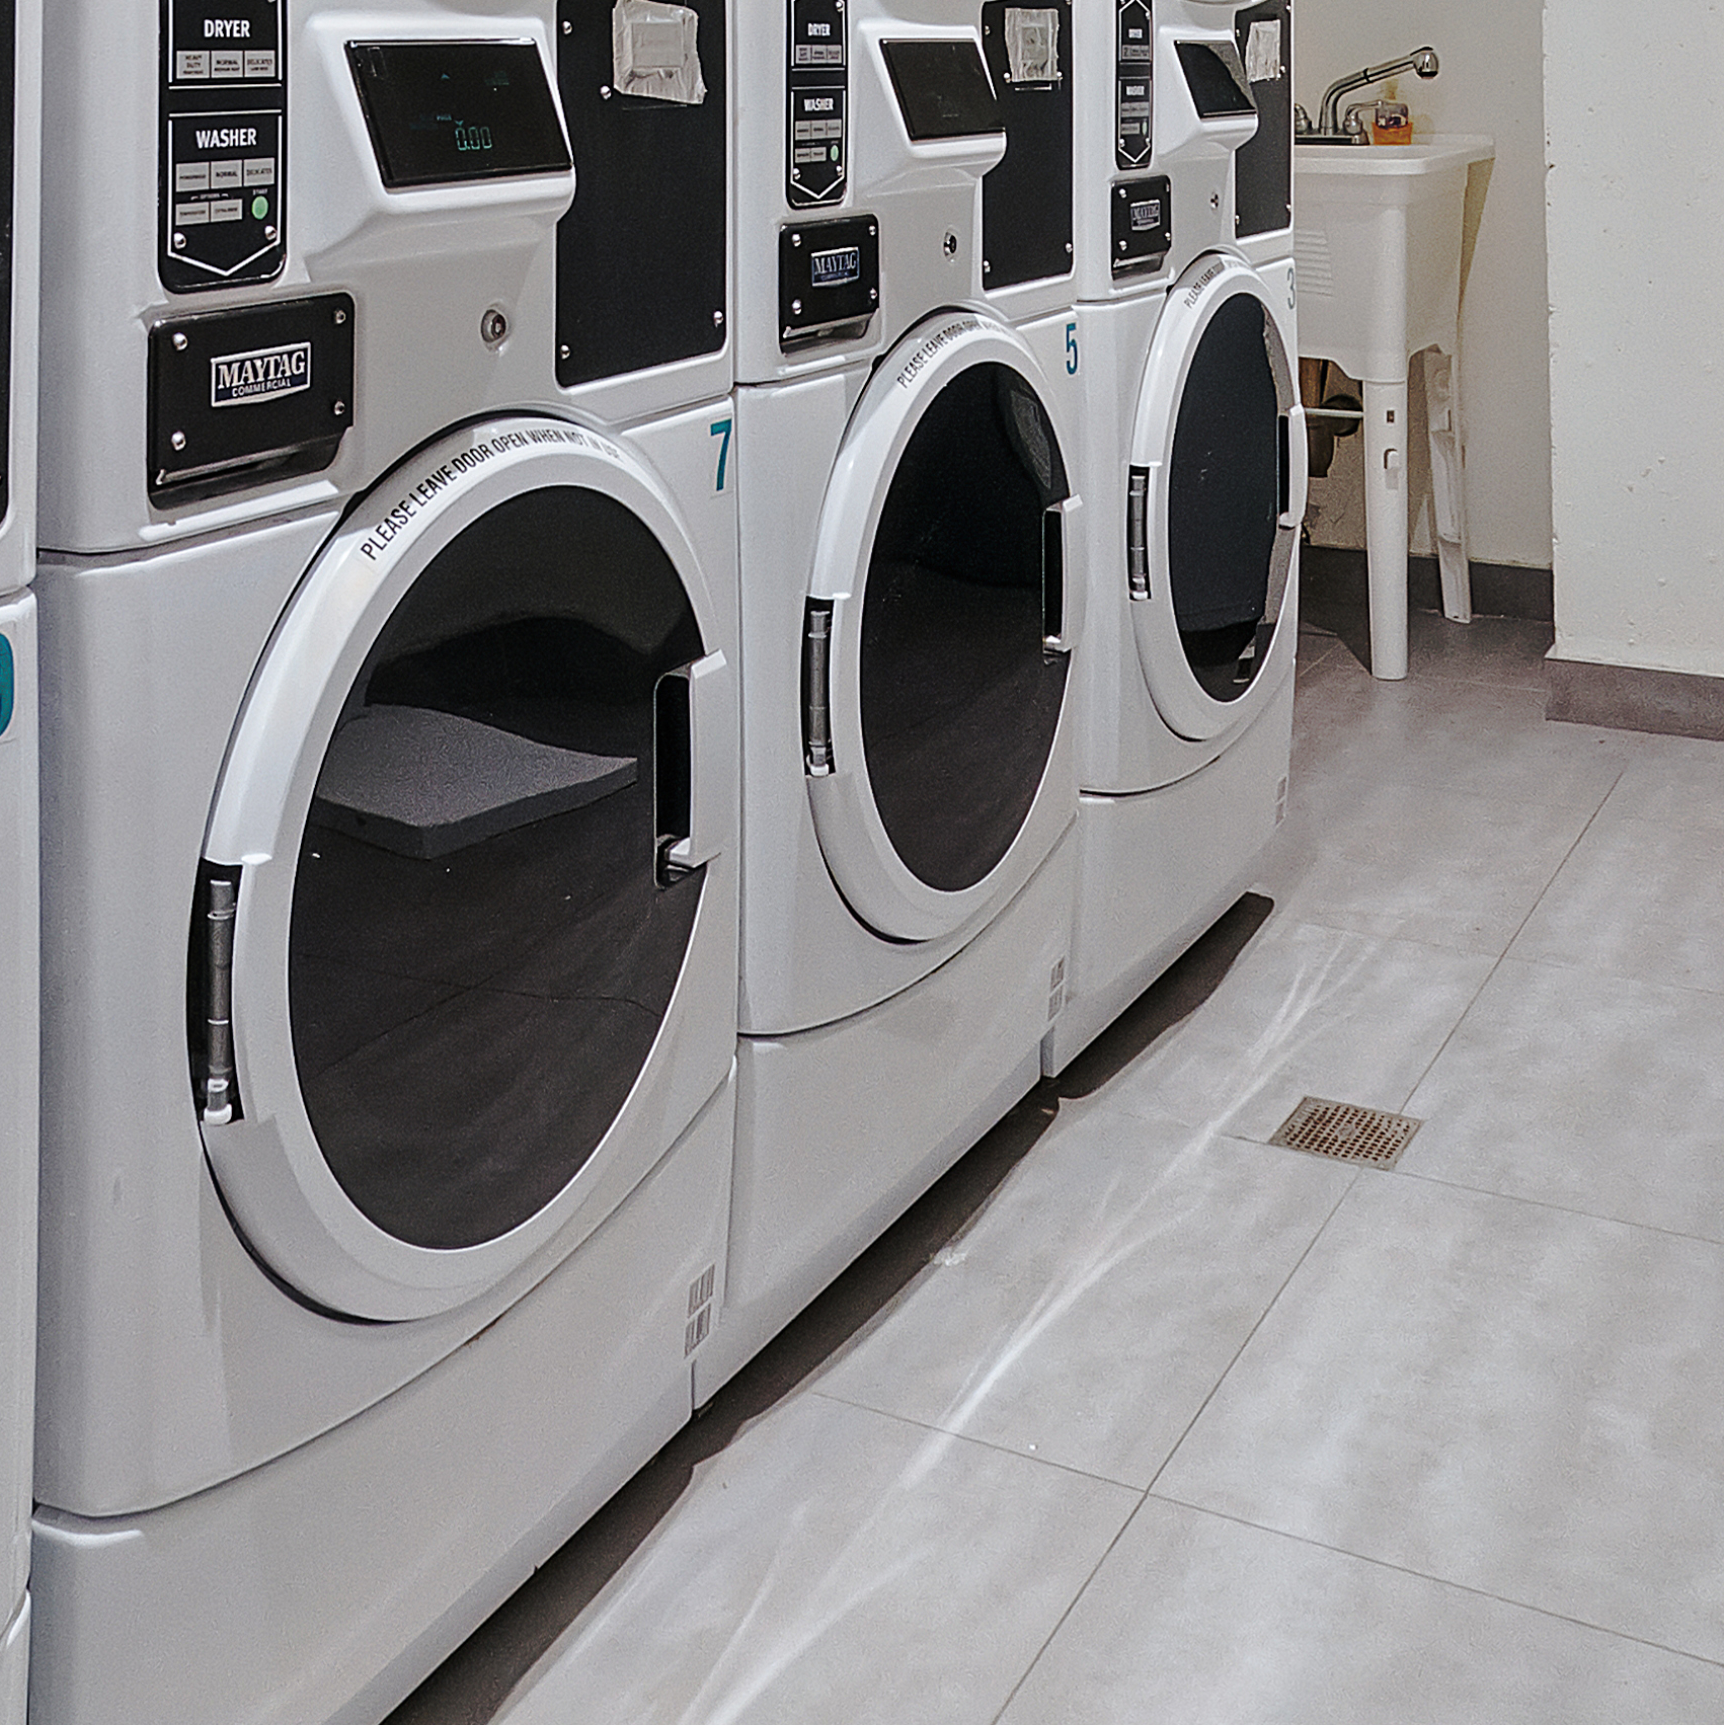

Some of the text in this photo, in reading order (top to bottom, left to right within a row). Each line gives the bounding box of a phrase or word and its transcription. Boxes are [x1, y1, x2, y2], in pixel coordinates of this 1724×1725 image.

[203, 19, 251, 38] DRYER
[807, 22, 831, 37] DRYER
[803, 97, 835, 112] WASHER
[195, 127, 258, 149] WASHER
[814, 251, 857, 276] MAYTAG
[1286, 267, 1296, 310] 3
[896, 352, 928, 390] PLEASE
[925, 332, 949, 359] LEAVE
[1065, 322, 1079, 376] 5
[217, 350, 306, 390] MAYTAG
[231, 377, 292, 397] COMMERCIAL
[709, 417, 733, 492] 7
[359, 499, 417, 561] PLEASE
[408, 464, 458, 508] LEAVE
[450, 443, 496, 475] DOOR
[490, 431, 530, 454] OPEN
[527, 428, 565, 445] WHEN
[564, 431, 587, 447] NOT
